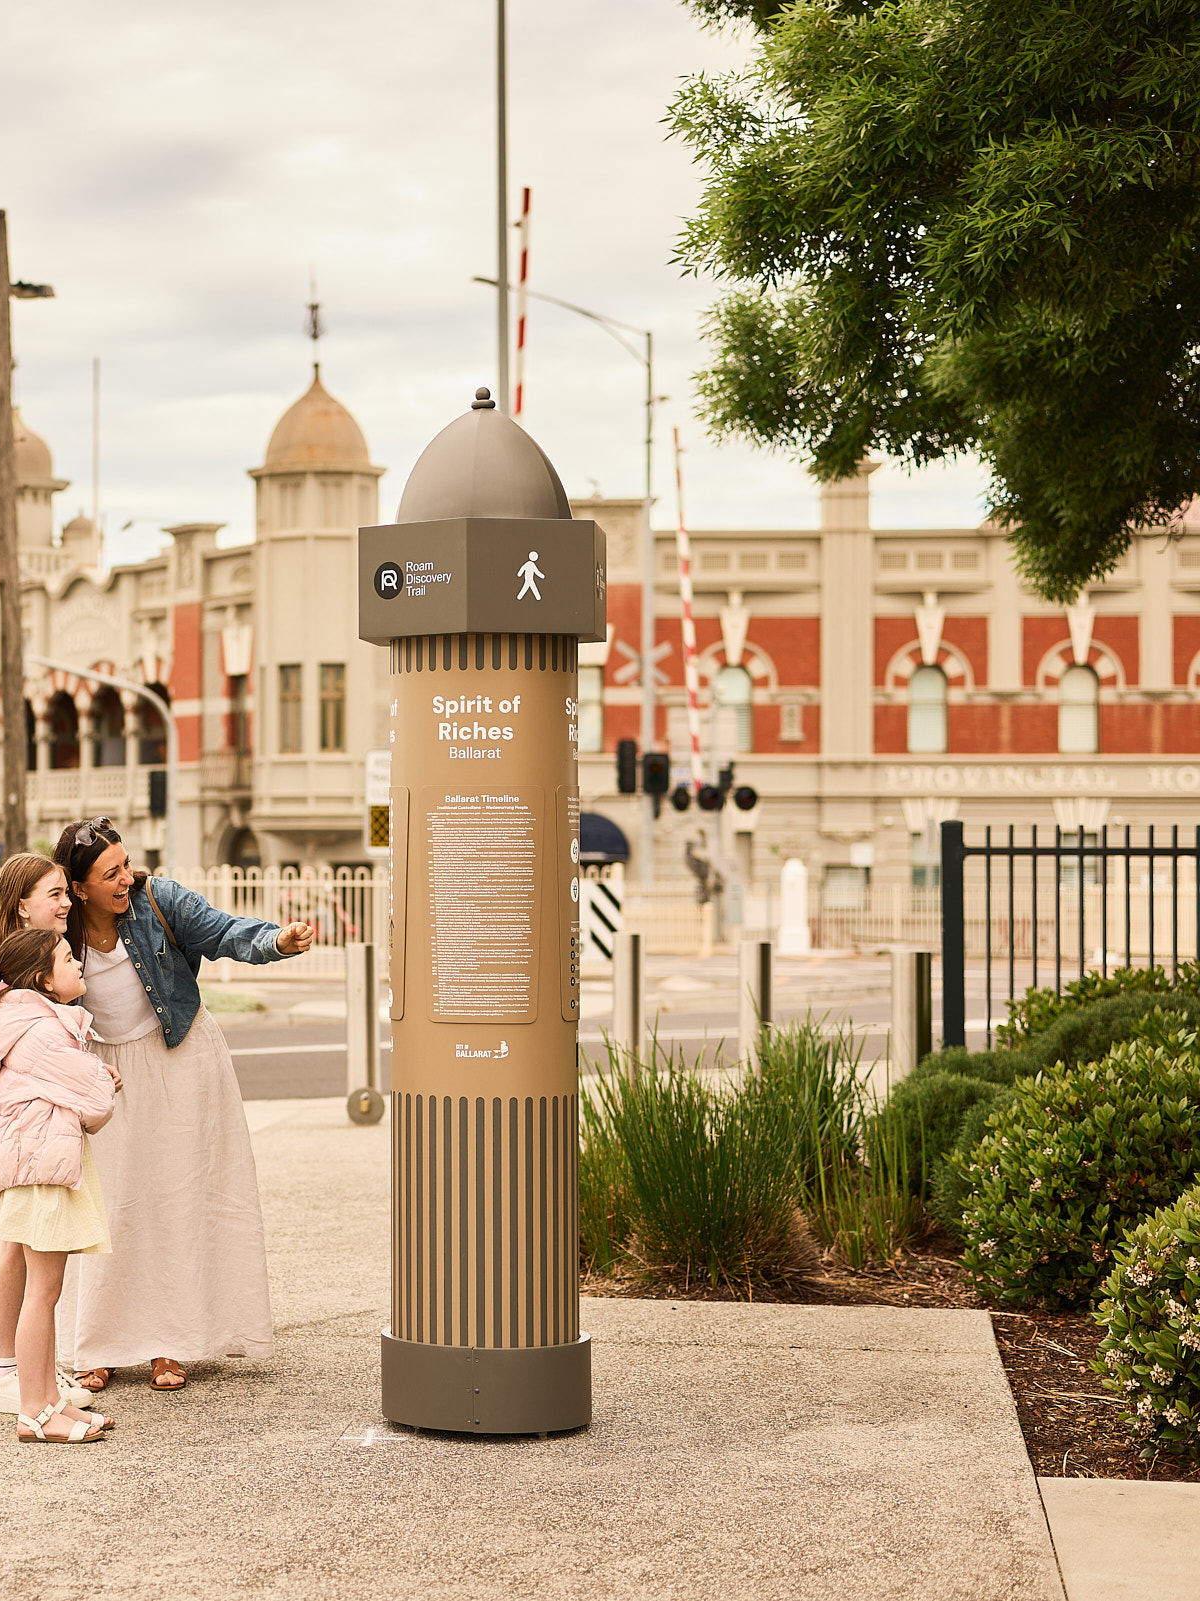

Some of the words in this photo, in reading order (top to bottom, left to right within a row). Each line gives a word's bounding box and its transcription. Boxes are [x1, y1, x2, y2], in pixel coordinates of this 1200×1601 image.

[405, 561, 434, 572] Roam
[405, 573, 452, 585] Discovery
[405, 585, 426, 597] Trail
[432, 695, 493, 719] Spirit
[498, 695, 521, 714] of
[438, 722, 514, 741] Riches
[449, 746, 502, 759] Ballarat
[885, 764, 1118, 791] PROVINCIAL
[445, 794, 480, 803] Ballarat
[480, 794, 520, 803] Timeline
[455, 1050, 492, 1058] BALLARAT
